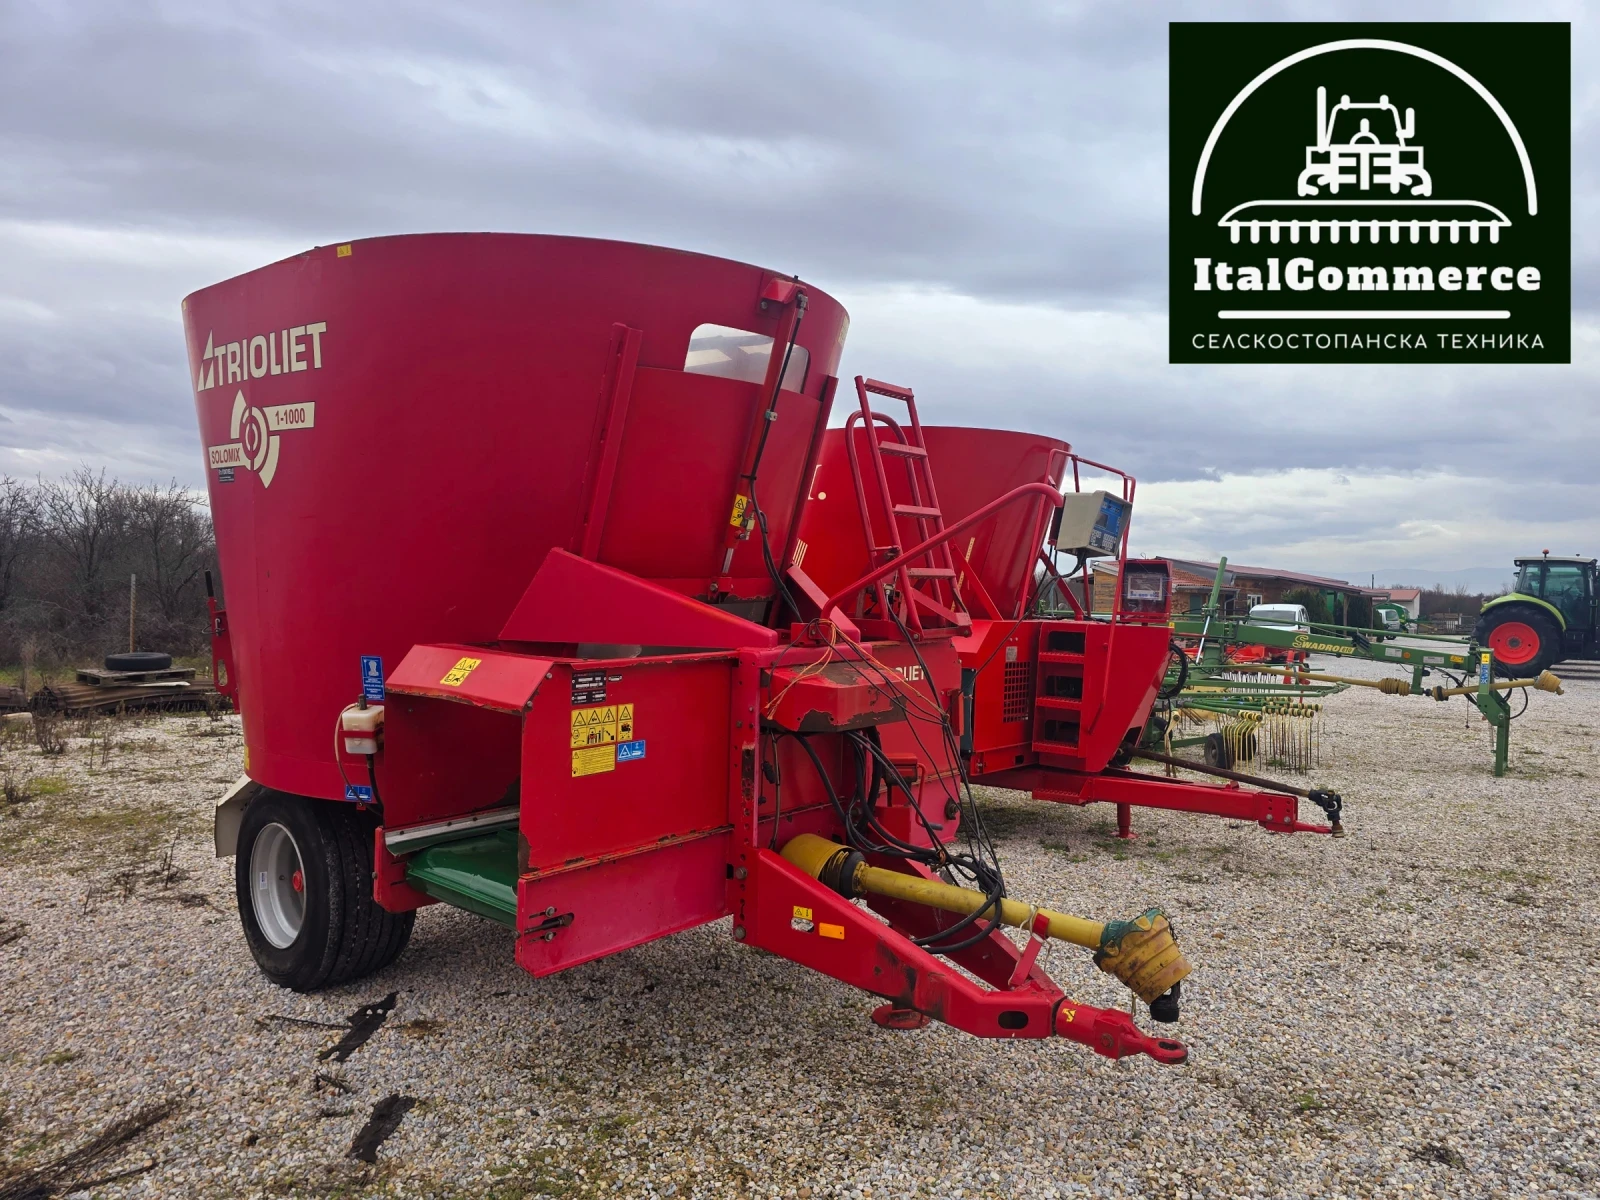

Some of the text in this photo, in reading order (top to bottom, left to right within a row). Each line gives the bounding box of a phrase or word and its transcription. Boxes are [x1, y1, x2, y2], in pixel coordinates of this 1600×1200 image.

[214, 321, 327, 387] TRIOLIET
[275, 407, 306, 425] 1-1000
[211, 448, 241, 464] SOLOMIX
